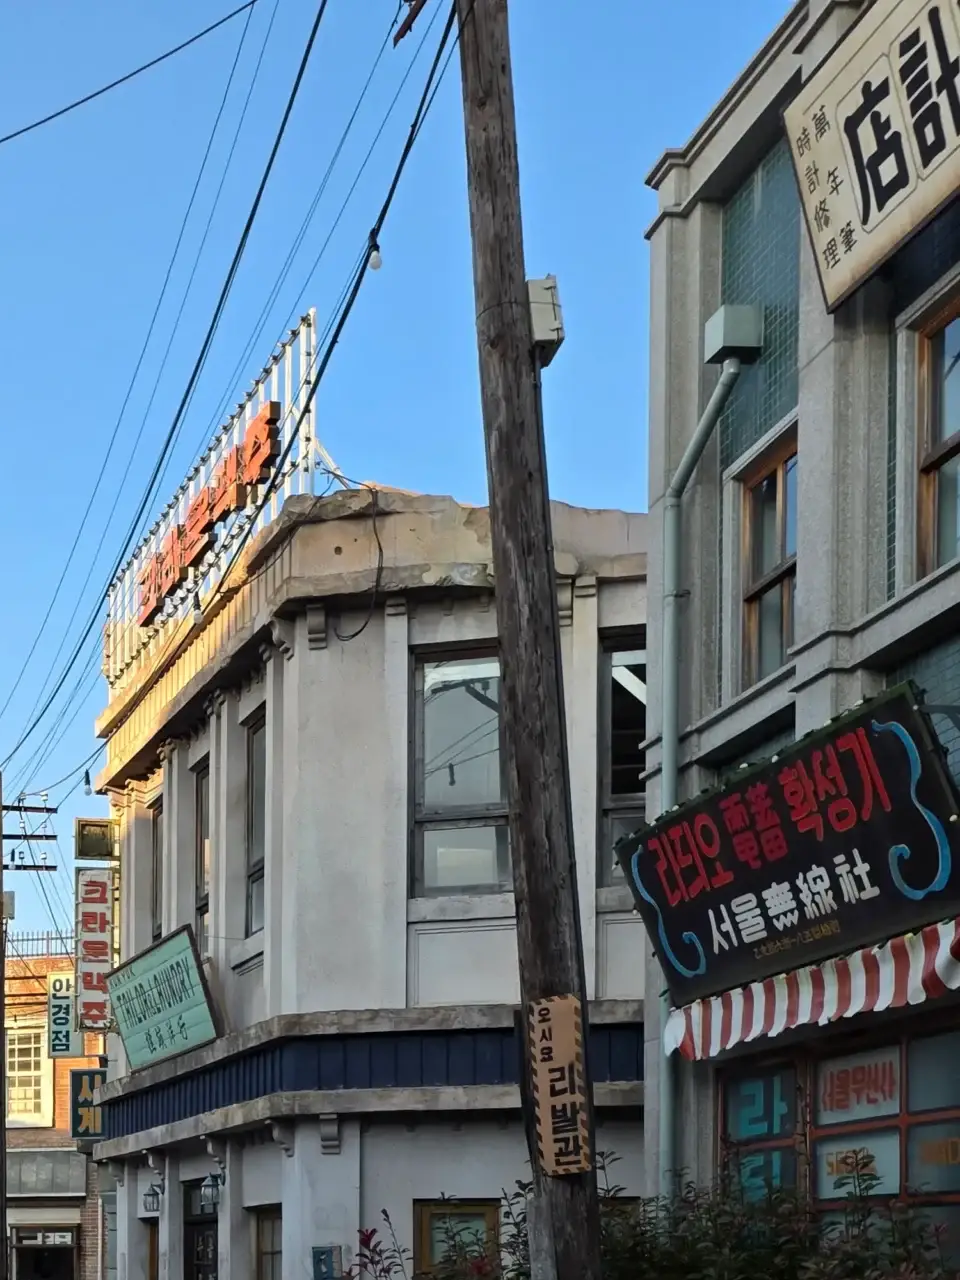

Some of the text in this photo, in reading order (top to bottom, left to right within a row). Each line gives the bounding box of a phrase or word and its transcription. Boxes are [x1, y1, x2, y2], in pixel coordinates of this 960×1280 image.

[777, 727, 892, 842] 확성기
[81, 880, 109, 1024] 크라운맥주
[148, 956, 195, 1014] LAUNDRY
[52, 978, 73, 1053] 안경점
[77, 1074, 102, 1134] 시계
[547, 1061, 584, 1167] 리발관
